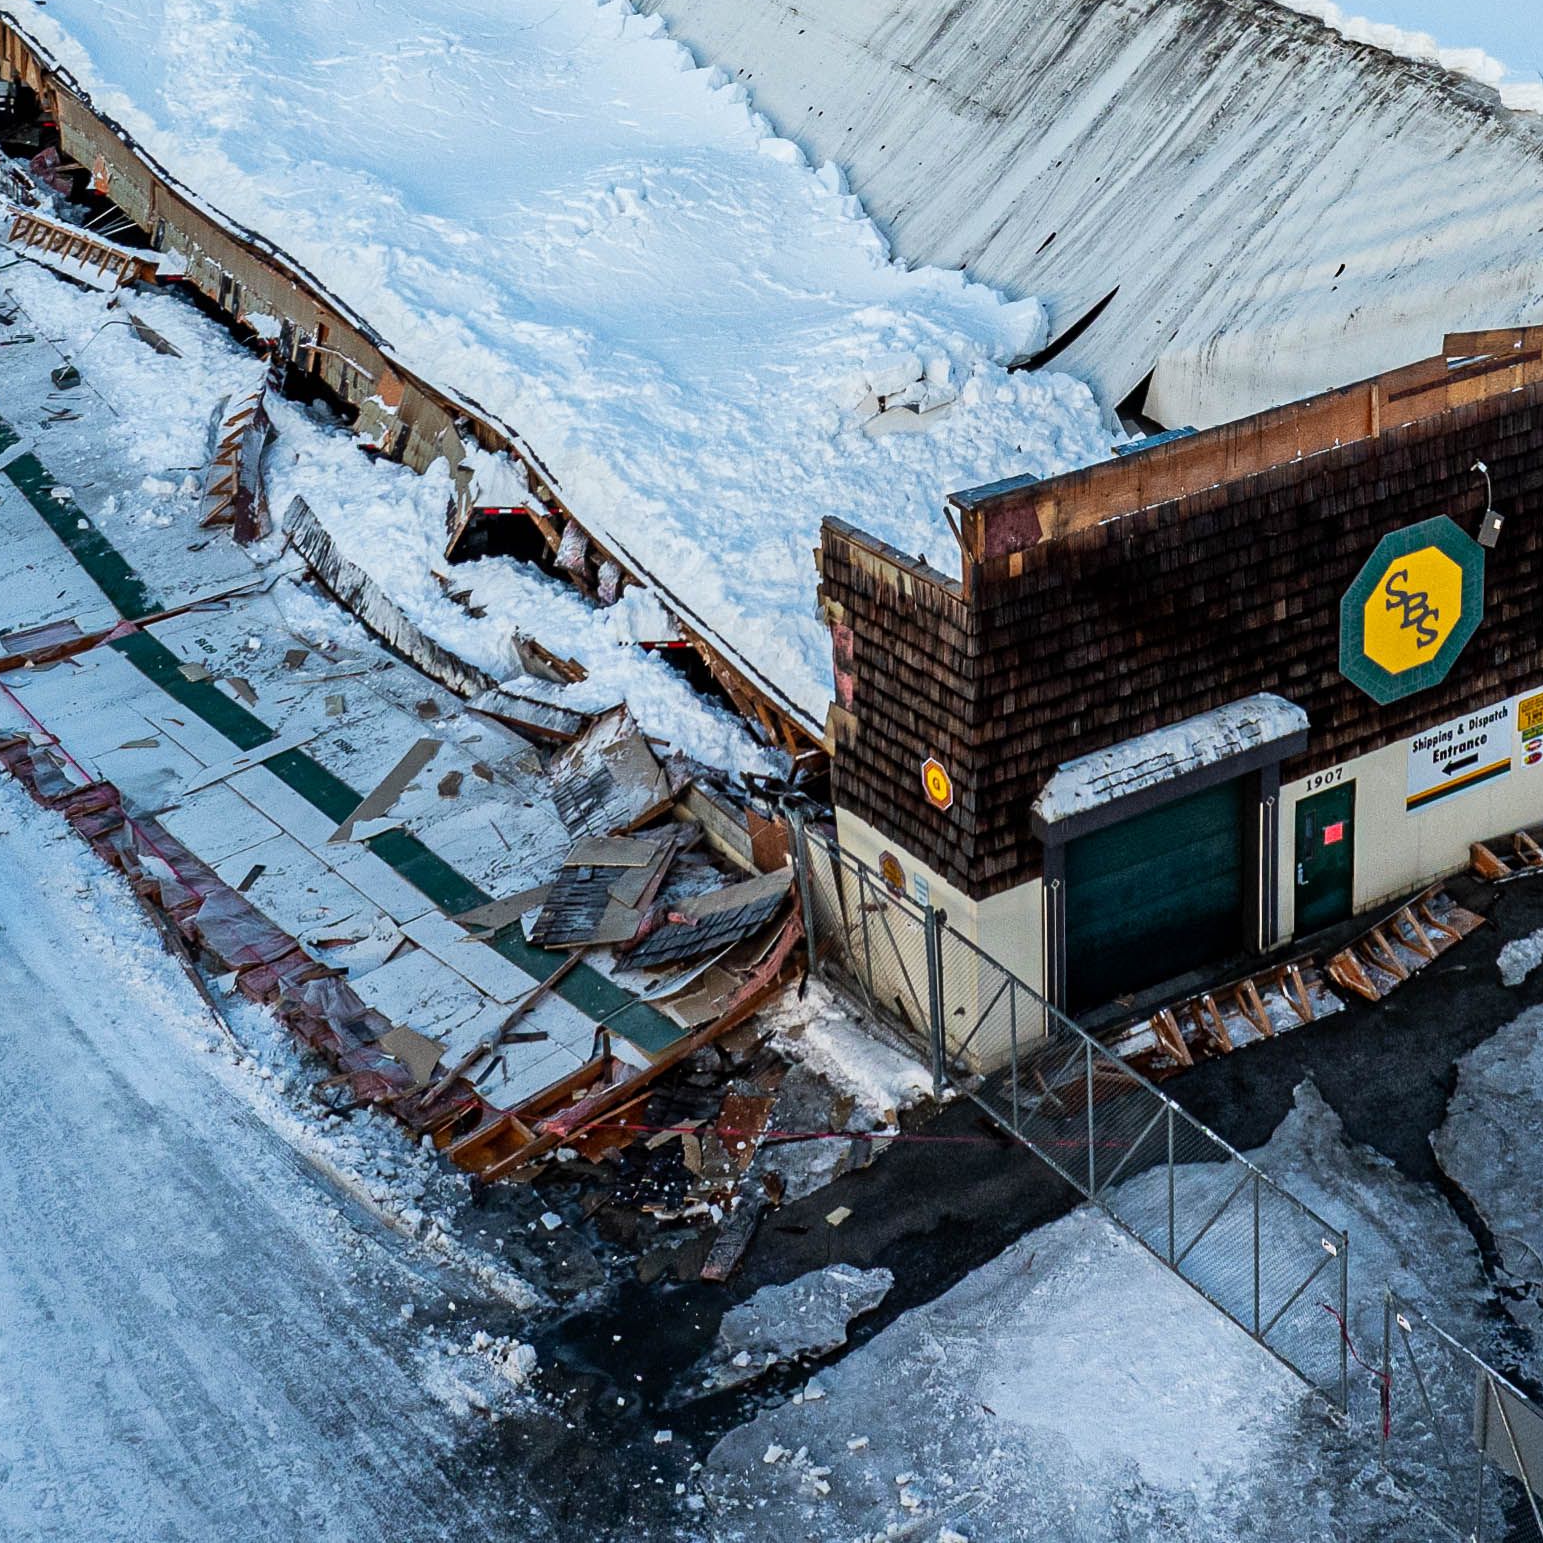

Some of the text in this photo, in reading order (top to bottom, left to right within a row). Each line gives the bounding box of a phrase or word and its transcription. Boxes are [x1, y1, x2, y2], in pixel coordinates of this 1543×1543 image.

[1385, 569, 1439, 649] SBS
[1412, 730, 1453, 753] Shipping
[1457, 723, 1465, 735] &
[1469, 706, 1508, 731] Dispatch
[1432, 734, 1488, 764] Entrance
[1306, 767, 1343, 792] 1907
